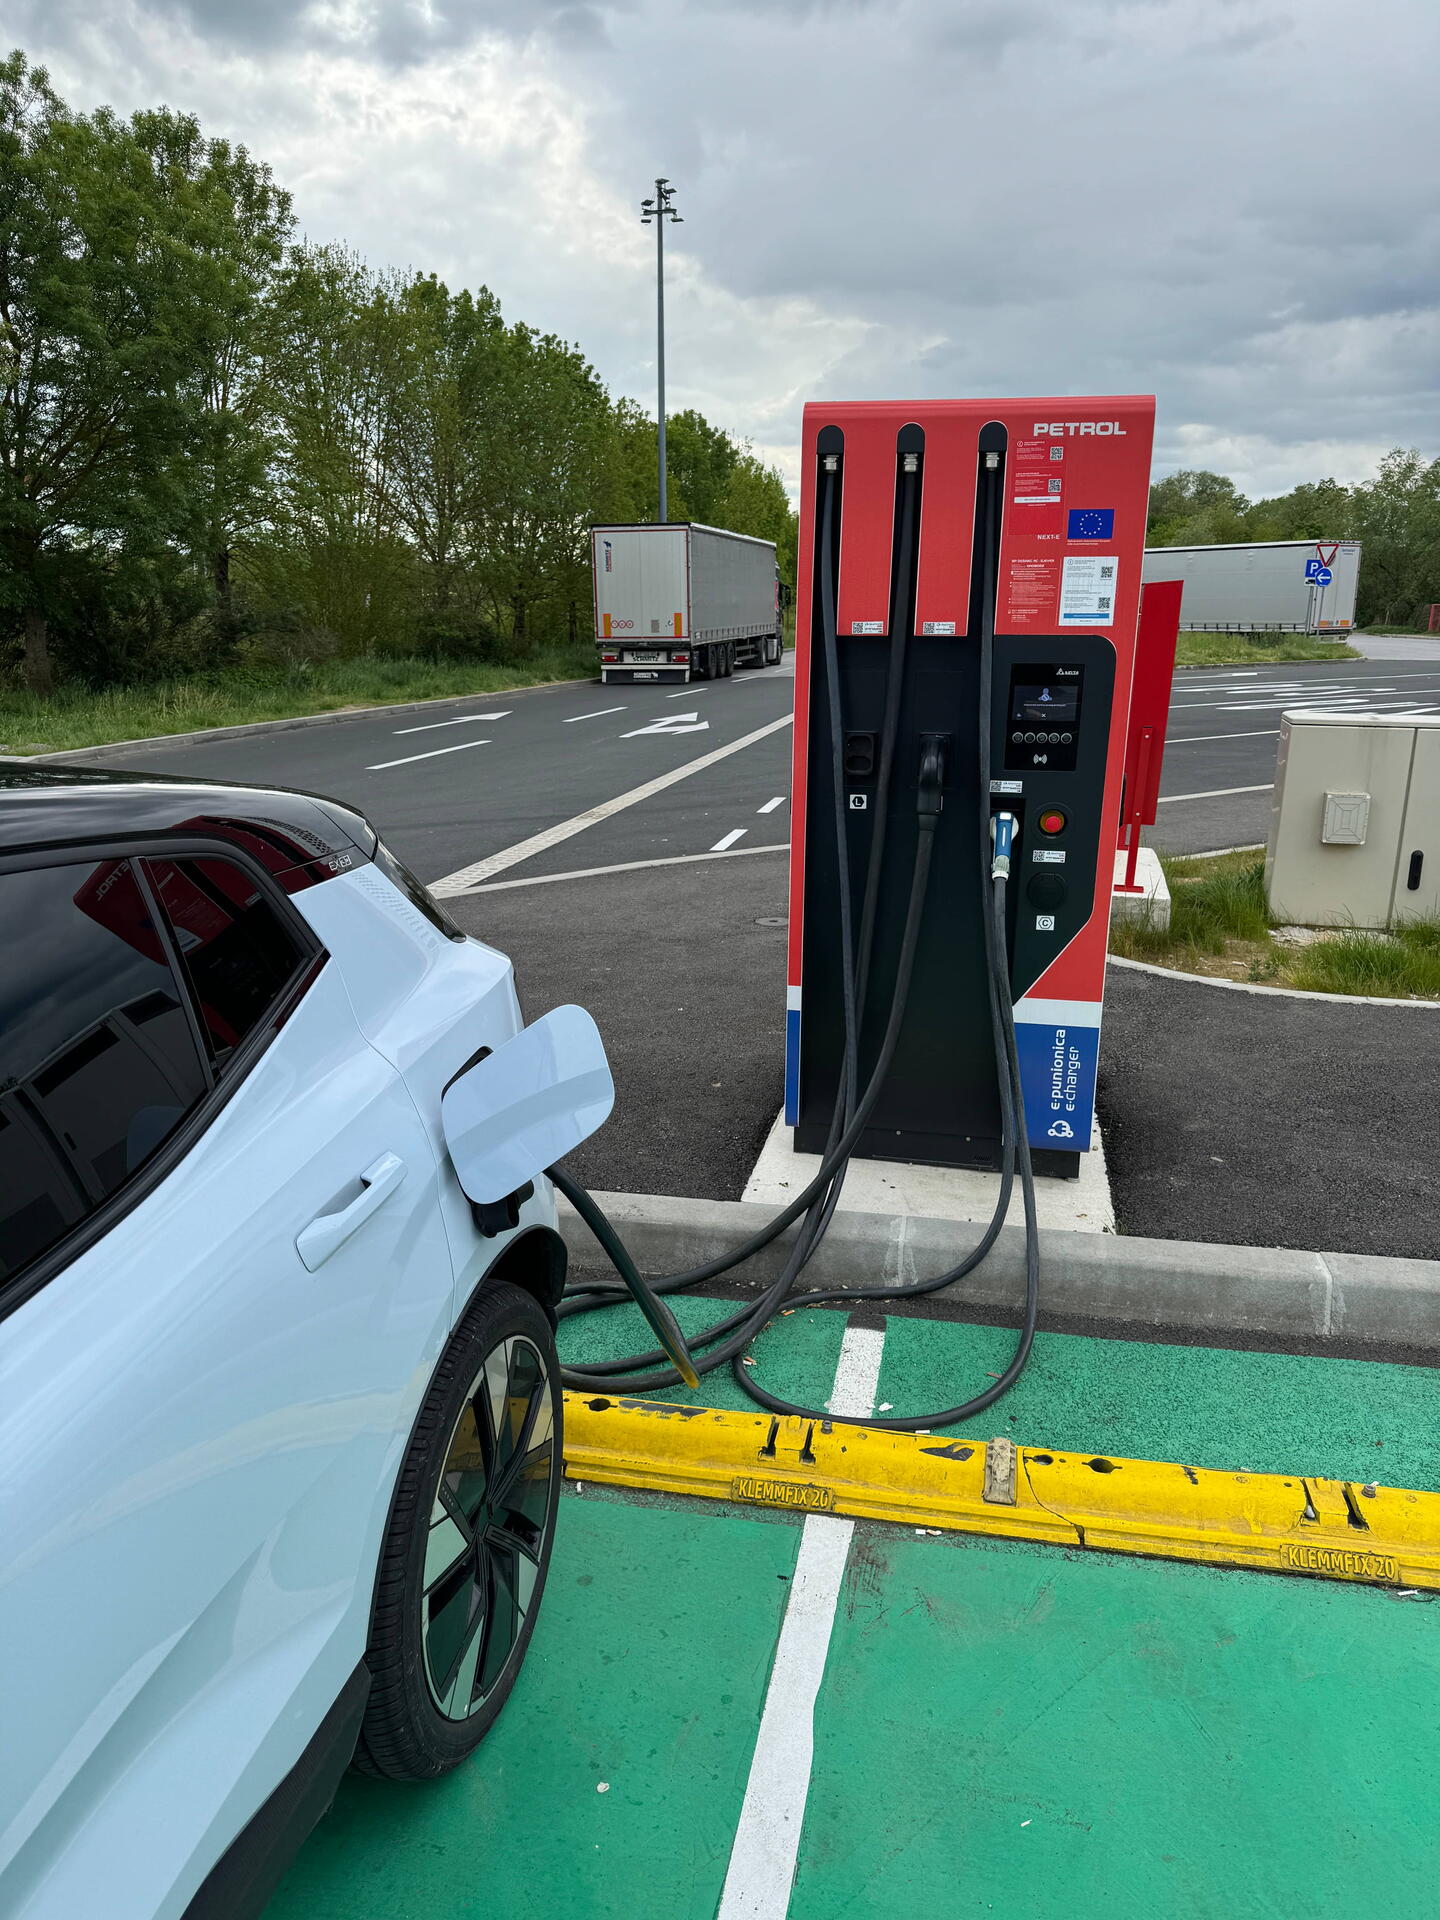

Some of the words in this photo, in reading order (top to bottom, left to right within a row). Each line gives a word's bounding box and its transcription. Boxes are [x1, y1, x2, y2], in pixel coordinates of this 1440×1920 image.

[1033, 422, 1127, 437] PETROL
[1310, 562, 1319, 574] P
[738, 1479, 808, 1505] KLEMMFIX
[809, 1489, 829, 1508] 20
[1288, 1547, 1371, 1576] KLEMMFIX
[1375, 1556, 1395, 1579] 20
